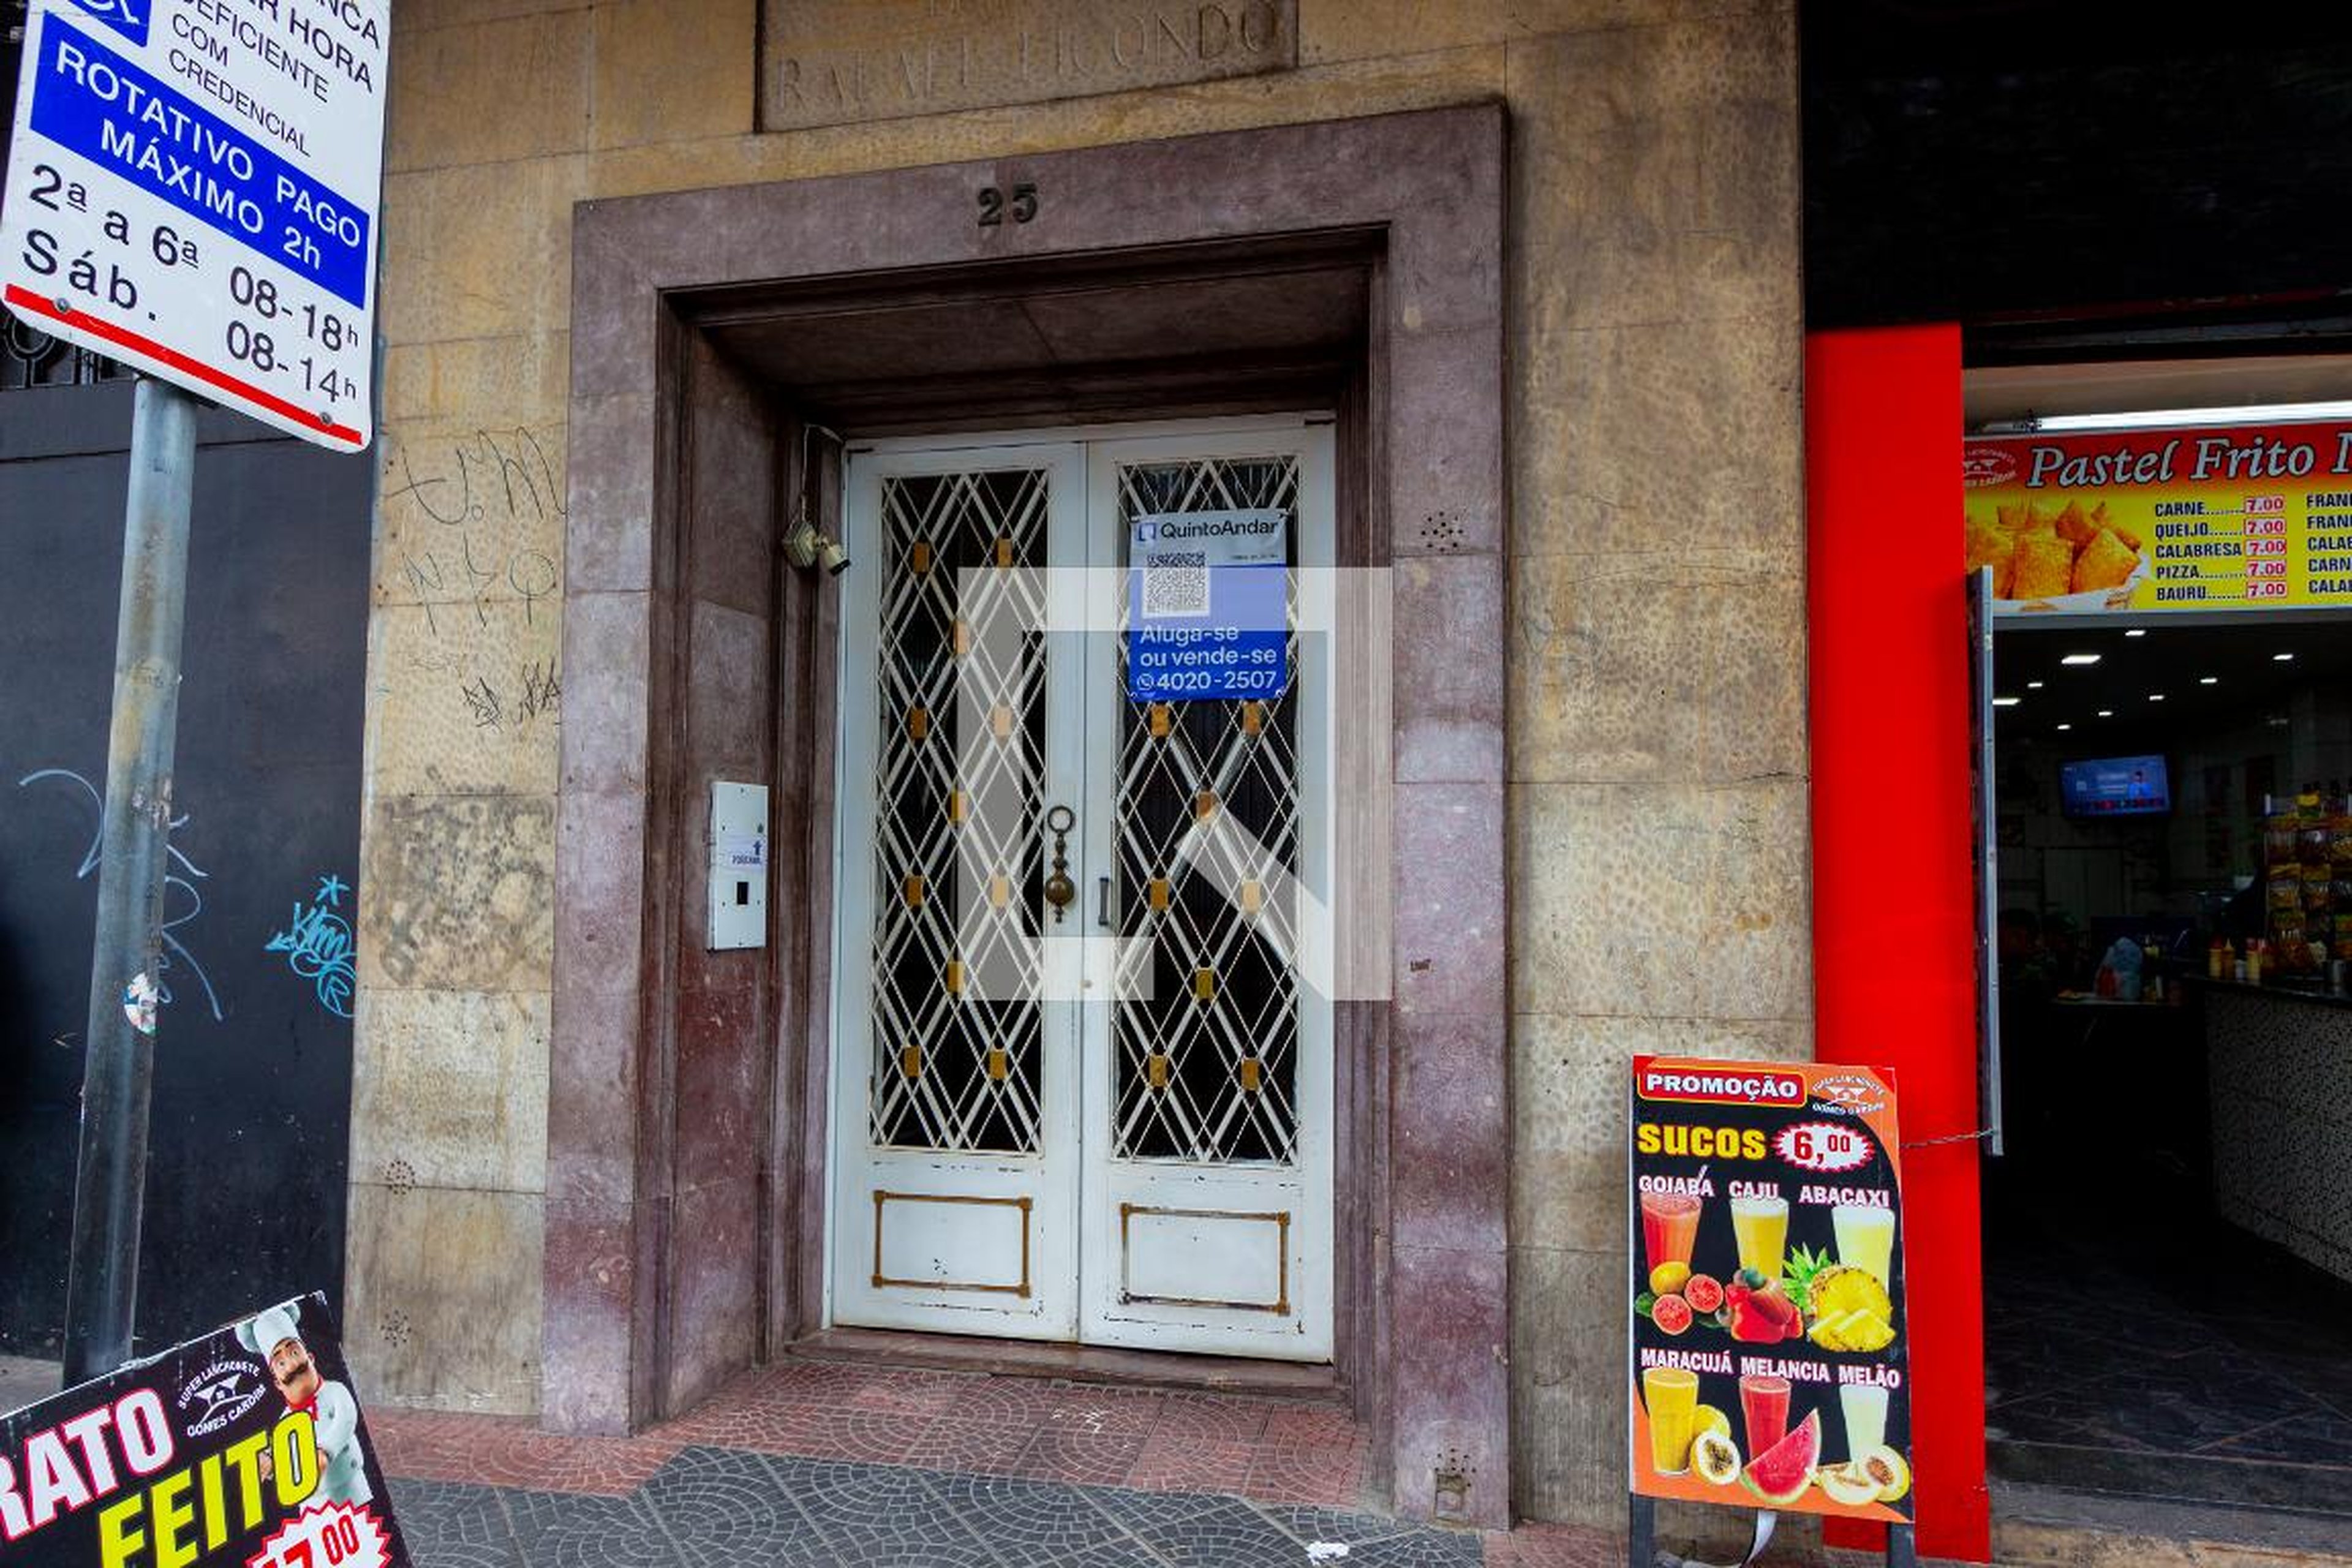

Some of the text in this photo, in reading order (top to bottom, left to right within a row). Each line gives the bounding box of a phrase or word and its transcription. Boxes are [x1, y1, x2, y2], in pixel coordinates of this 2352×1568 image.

[172, 13, 228, 67] COM
[181, 0, 330, 103] EFICIENTE
[289, 7, 372, 93] HORA
[169, 48, 311, 157] CREDENCIAL
[56, 40, 361, 248] ROTATIVO PAGO
[101, 120, 322, 271] MÁXIMO 2h
[978, 183, 1038, 228] 25
[103, 210, 129, 246] a
[23, 228, 156, 322] Sáb.
[2026, 439, 2180, 488] Pastel
[2190, 436, 2315, 480] Frito
[2155, 497, 2283, 517] CARNE 7.00
[2306, 493, 2352, 508] FRAN
[1160, 519, 1279, 540] QuintoAndar
[2155, 521, 2283, 540] QUEIJO 7.00
[2307, 514, 2352, 530] FRAN
[2155, 540, 2286, 559] CALABRESA 7.00
[2309, 557, 2351, 572] CARN
[2157, 562, 2286, 580] PIZZA 7.00
[2157, 583, 2286, 601] BAURU 7.00
[1140, 624, 1239, 647] Aluga-se
[1140, 646, 1277, 666] ou vende-se
[1646, 1074, 1798, 1101] PROMOÇÃO
[1637, 1123, 1850, 1164] SUCOS 6,00
[1638, 1174, 1890, 1208] GOIABA CAJU ABACAXI
[1641, 1348, 1901, 1389] MARACUJÁ MELANCIA MELÃO
[99, 1411, 320, 1568] FEITO
